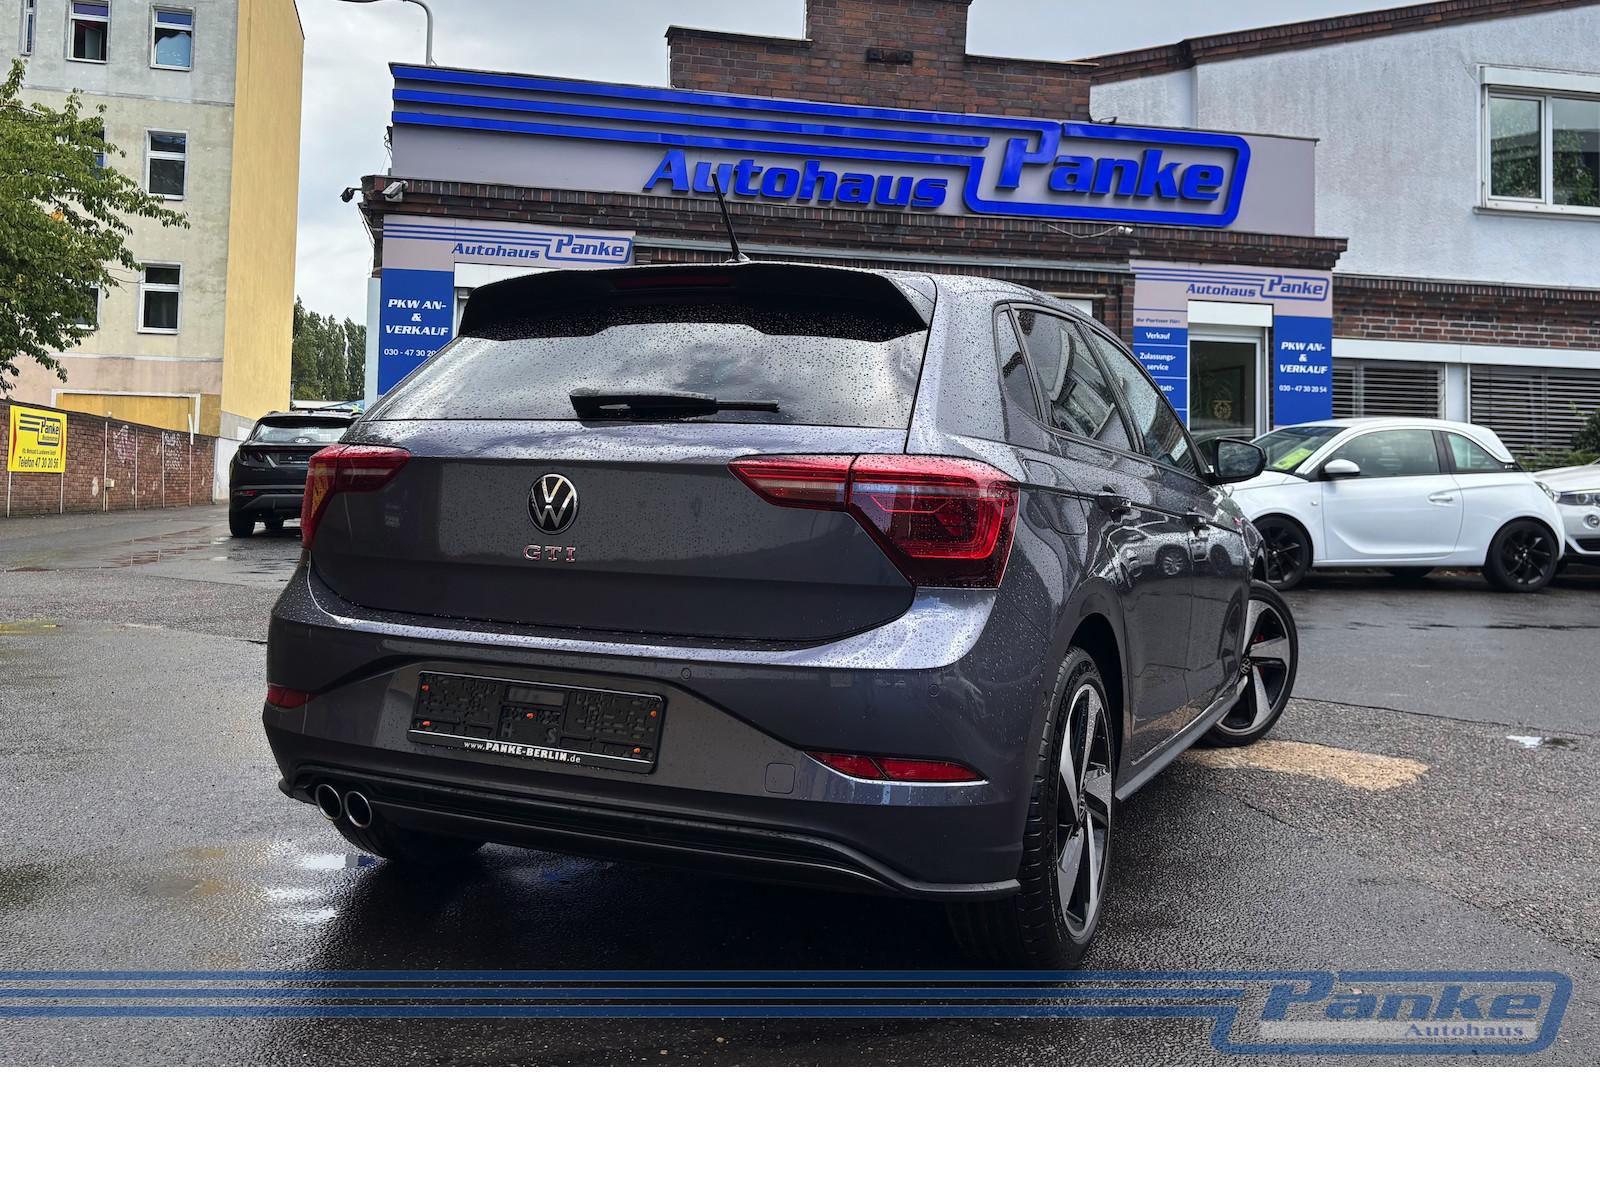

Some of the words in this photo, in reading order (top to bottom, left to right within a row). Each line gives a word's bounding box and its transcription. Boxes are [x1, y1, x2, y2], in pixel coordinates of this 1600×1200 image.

[643, 150, 948, 208] Autohaus
[996, 121, 1225, 202] Panke
[451, 242, 540, 259] Autohaus
[555, 234, 625, 257] Panke
[1186, 283, 1256, 297] Autohaus
[1267, 275, 1323, 296] Panke
[388, 299, 420, 309] PKW
[422, 301, 447, 310] AN-
[411, 313, 422, 322] &
[385, 325, 449, 336] VERKAUF
[1145, 332, 1170, 340] Verkauf
[1281, 341, 1306, 350] PKW
[1306, 343, 1326, 351] AN-
[383, 348, 399, 356] 030
[1139, 352, 1176, 361] Zulassungs-
[1298, 353, 1308, 362] &
[1147, 363, 1169, 371] service
[1279, 364, 1328, 374] VERKAUF
[40, 418, 59, 435] Panke
[19, 456, 35, 468] Telefon
[529, 475, 576, 531] VW
[523, 544, 576, 562] GTI
[463, 741, 581, 763] www.PANKE-BERLIN.de
